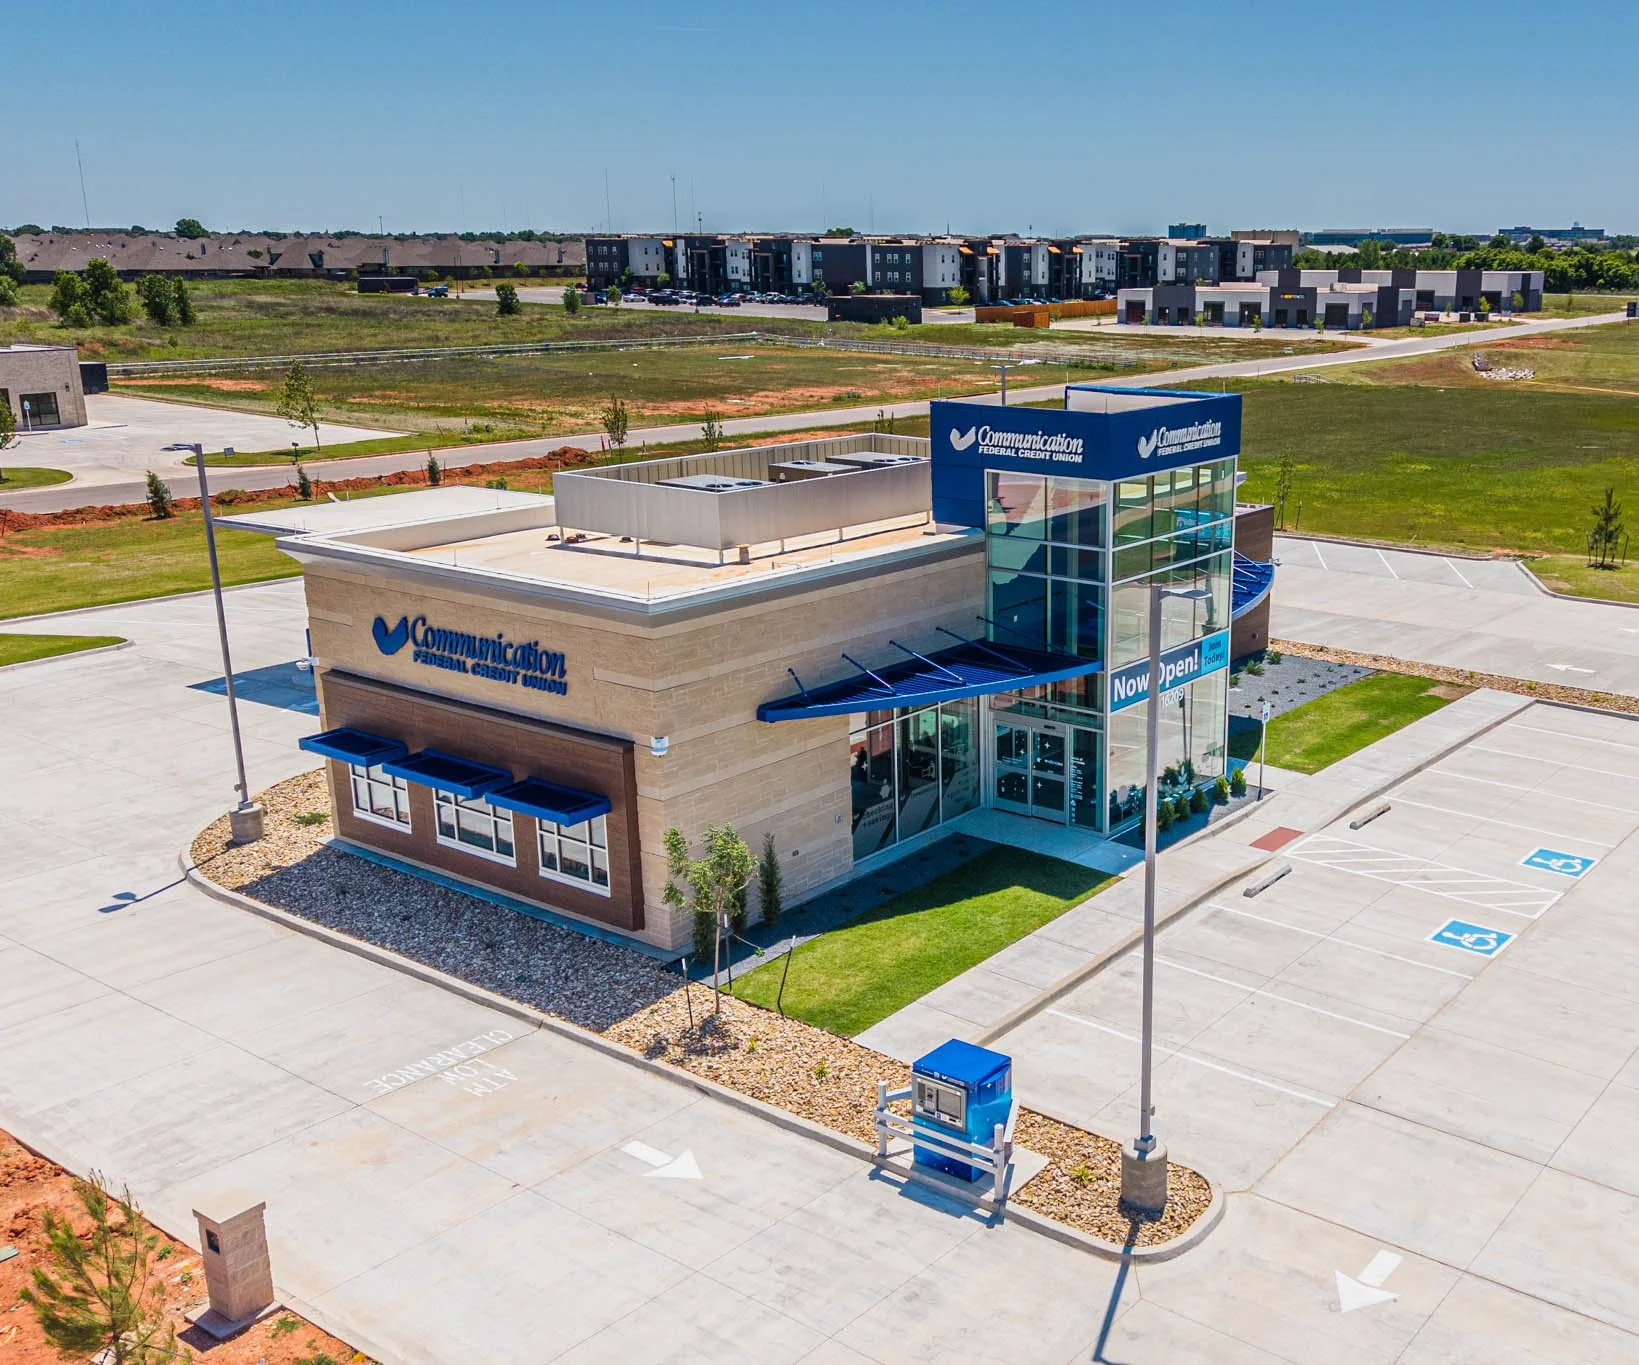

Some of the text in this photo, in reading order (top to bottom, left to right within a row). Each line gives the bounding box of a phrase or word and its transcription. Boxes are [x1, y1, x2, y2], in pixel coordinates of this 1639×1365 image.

[978, 425, 1083, 453] Communication
[1157, 419, 1221, 447] Communication
[978, 446, 1083, 463] FEDERAL CREDIT UNION
[409, 615, 567, 679] Communication
[1204, 650, 1225, 666] Today!
[413, 650, 568, 696] FEDERAL CREDIT UNION
[1113, 672, 1150, 702] Now
[362, 1029, 513, 1094] CLEARANCE
[438, 1058, 495, 1085] LOW
[464, 1068, 519, 1096] ATM
